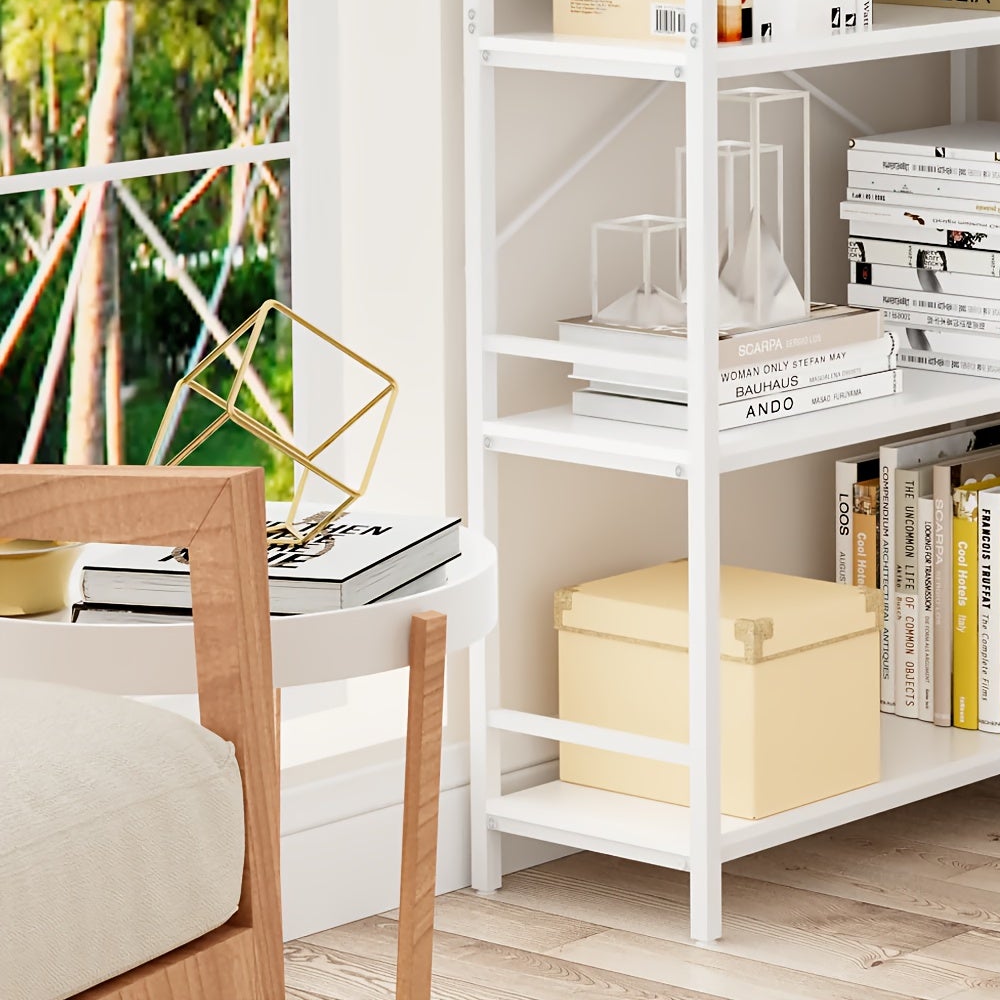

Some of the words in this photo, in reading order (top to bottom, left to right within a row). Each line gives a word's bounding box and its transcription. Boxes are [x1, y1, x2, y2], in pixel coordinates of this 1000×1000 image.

[738, 338, 783, 358] SCARPA
[720, 367, 760, 383] WOMAN
[763, 358, 789, 375] ONLY
[792, 355, 826, 369] STEFAN
[829, 351, 847, 364] MAY
[735, 375, 800, 398] BAUHAUS
[745, 396, 795, 419] ANDO
[904, 480, 915, 501] THE
[839, 493, 850, 536] LOOS
[904, 506, 915, 559] UNCOMMON
[936, 498, 944, 566] SCARPA
[855, 532, 867, 558] Cool
[981, 508, 991, 560] FRANCOIS
[839, 551, 847, 584] AUGUS
[957, 541, 968, 566] Cool
[881, 541, 889, 618] ARCHITECTURAL
[904, 564, 915, 592] LIFE
[924, 565, 932, 612] TRANSMISSION
[957, 569, 967, 607] Hotels
[981, 561, 991, 610] TRUFFAT
[905, 596, 914, 610] OF
[904, 615, 914, 656] COMMON
[981, 630, 989, 667] Complete
[905, 660, 915, 708] OBJECTS
